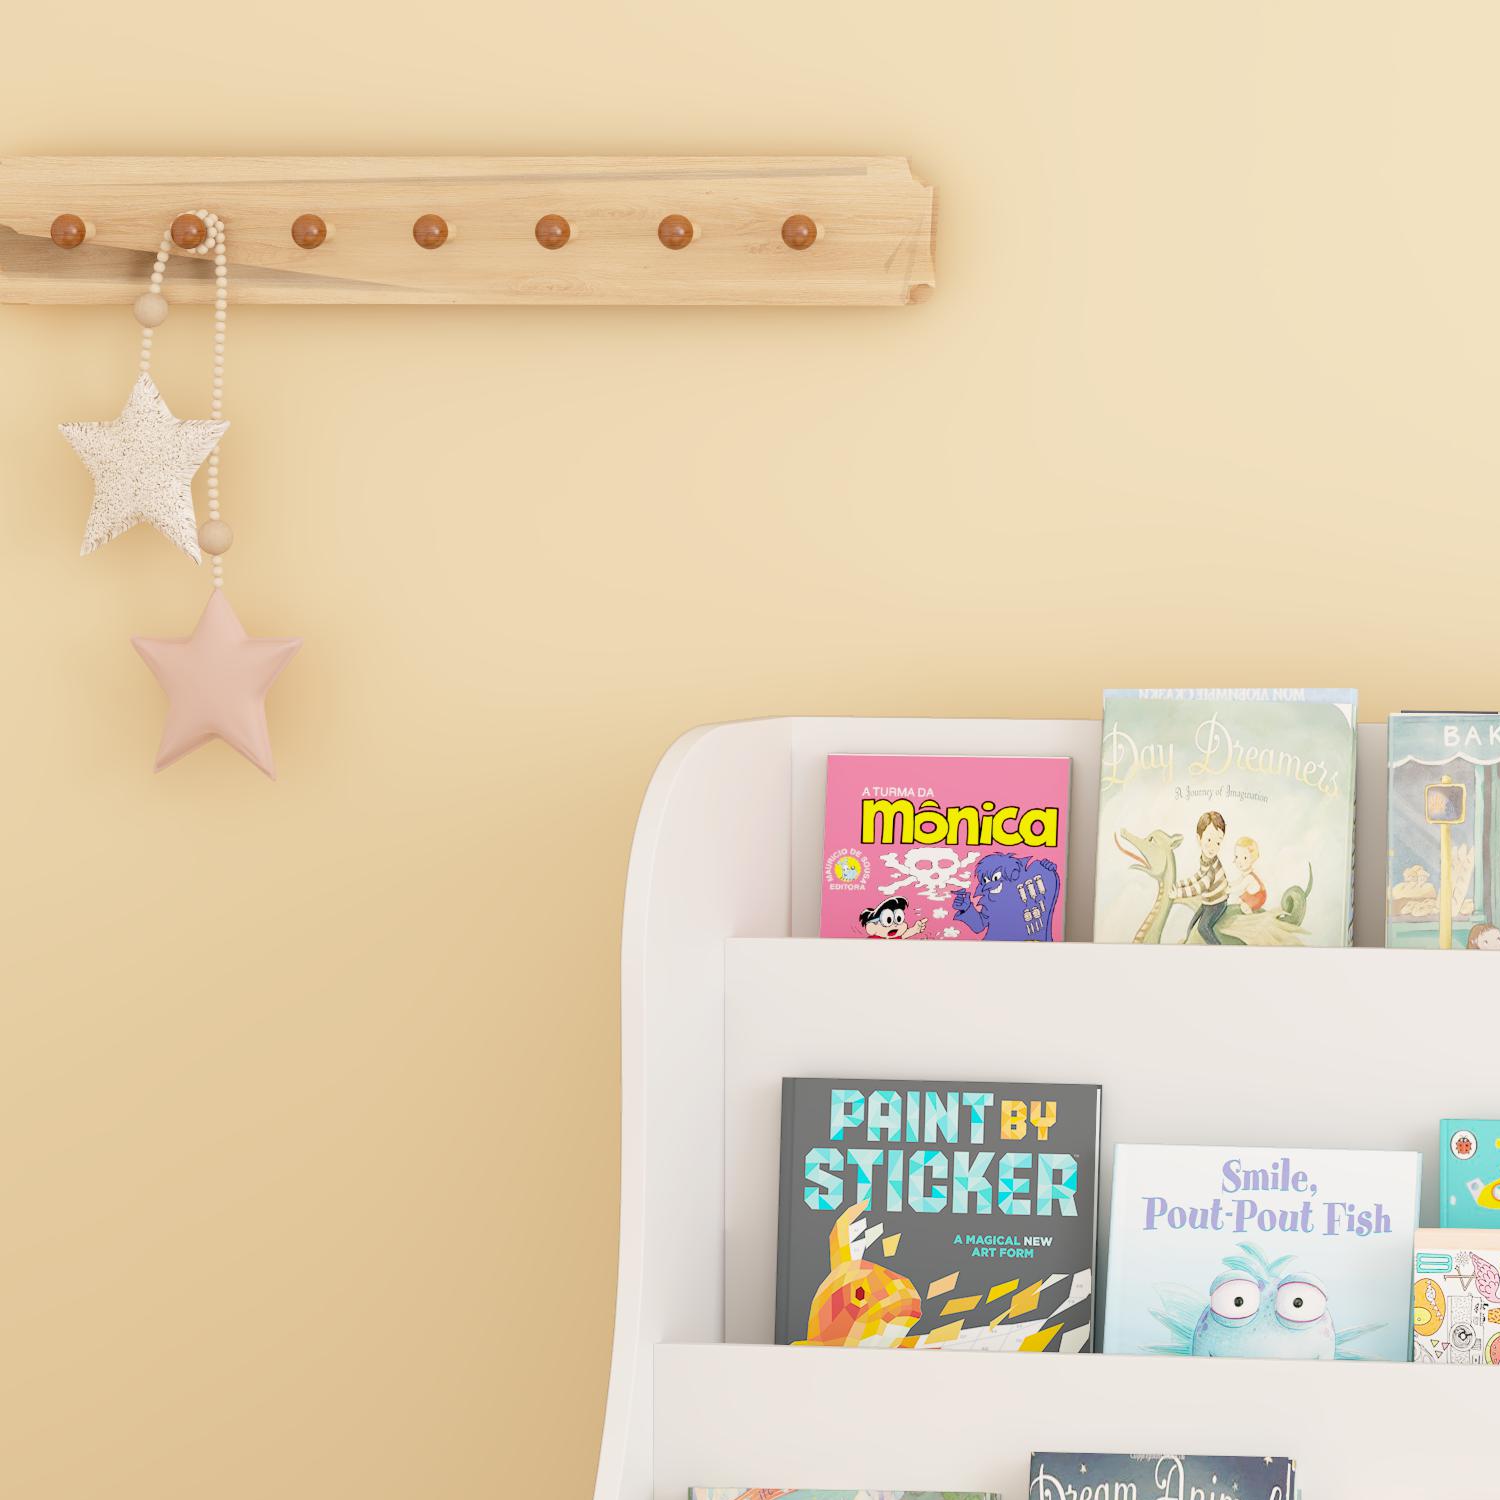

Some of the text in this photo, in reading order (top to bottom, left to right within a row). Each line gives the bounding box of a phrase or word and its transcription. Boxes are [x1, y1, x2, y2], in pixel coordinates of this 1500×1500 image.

[1101, 711, 1341, 798] Day Dreamers
[861, 787, 934, 797] A TURMA DA
[1185, 785, 1212, 800] Journey
[1215, 785, 1223, 797] of
[1226, 784, 1269, 803] Imagination
[825, 848, 871, 884] MAURICIO DE SOUSA
[829, 1089, 1057, 1144] PAINT BY
[804, 1147, 1079, 1217] STICKER
[1222, 1157, 1318, 1197] Smile,
[1141, 1197, 1393, 1237] Pout-Pout Fish
[953, 1234, 1053, 1247] A MAGICAL NEW
[971, 1247, 1034, 1258] ART FORM
